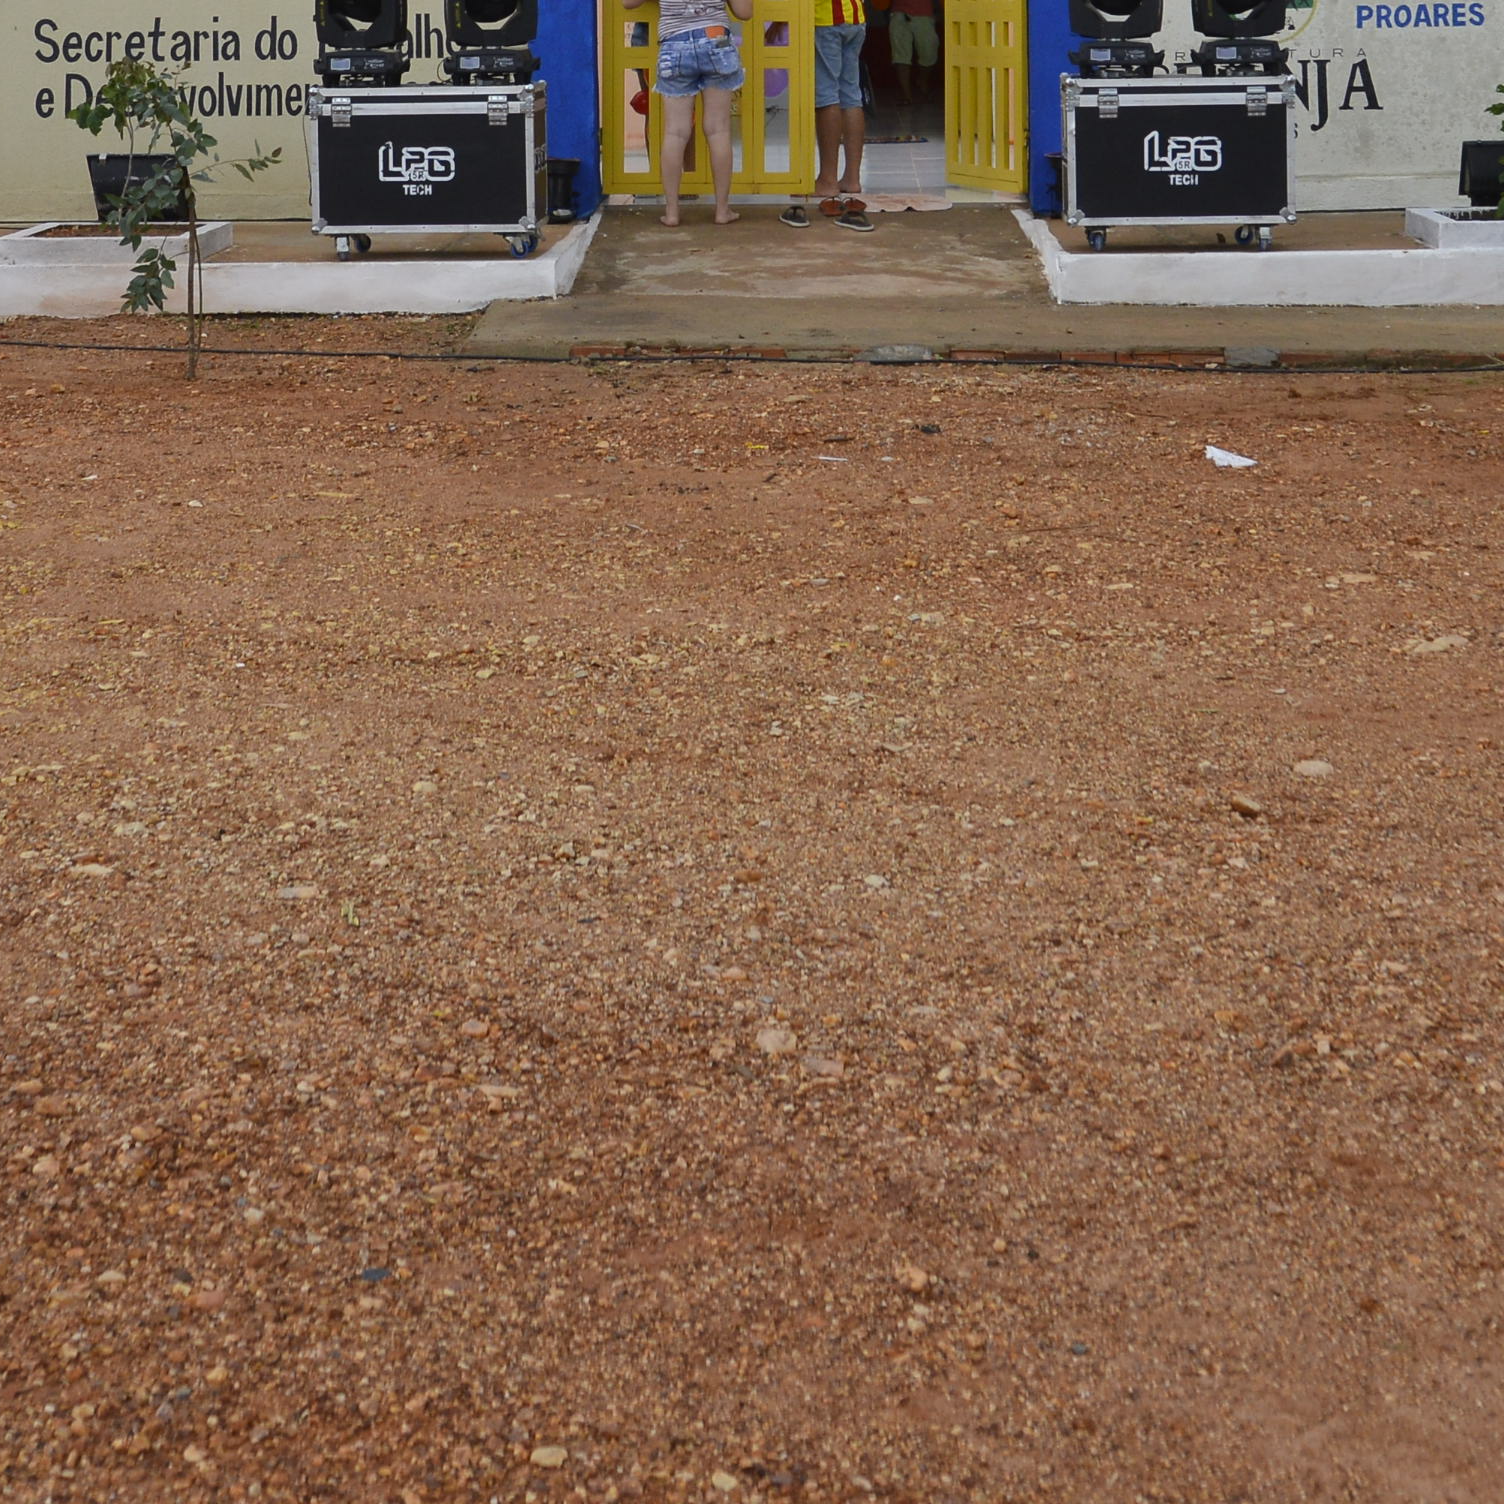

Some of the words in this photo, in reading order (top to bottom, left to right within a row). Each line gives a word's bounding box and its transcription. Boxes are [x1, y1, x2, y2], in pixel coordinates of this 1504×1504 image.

[1356, 3, 1485, 30] PROARES
[34, 16, 241, 63] Secretaria
[254, 15, 298, 61] do
[35, 86, 55, 118] e
[378, 140, 456, 182] LPG
[1143, 130, 1222, 172] LPG
[402, 184, 432, 196] TECH
[1168, 174, 1199, 186] TECH
